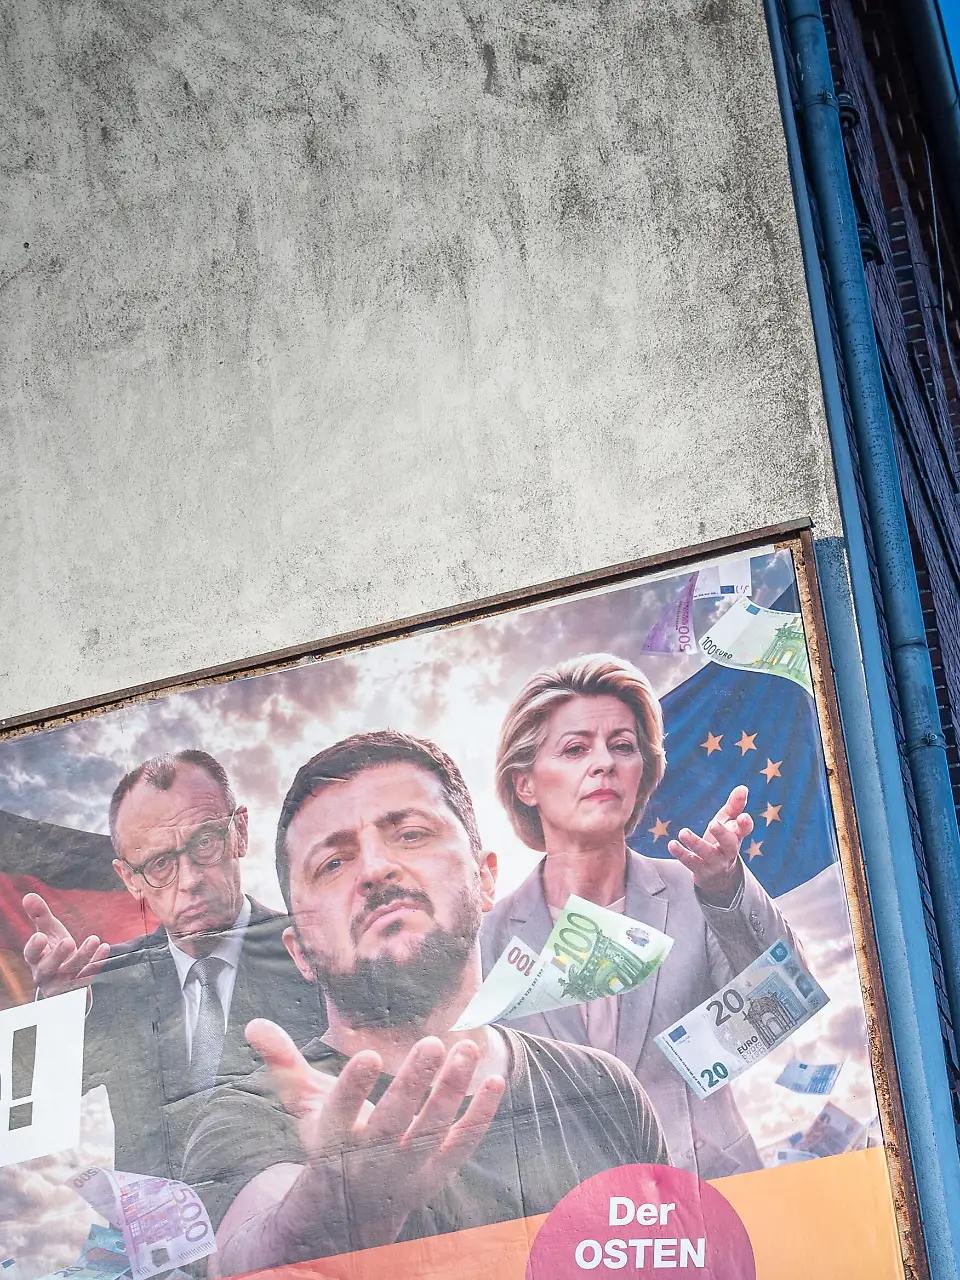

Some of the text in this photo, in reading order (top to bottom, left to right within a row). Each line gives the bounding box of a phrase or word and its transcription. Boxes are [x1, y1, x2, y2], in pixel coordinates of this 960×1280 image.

[701, 636, 717, 655] 100
[553, 912, 600, 965] 100
[706, 988, 745, 1027] 20
[737, 1035, 758, 1055] EURO
[700, 1061, 729, 1089] 20
[173, 1187, 209, 1242] 500
[609, 1196, 675, 1226] Der
[575, 1238, 705, 1269] OSTEN
